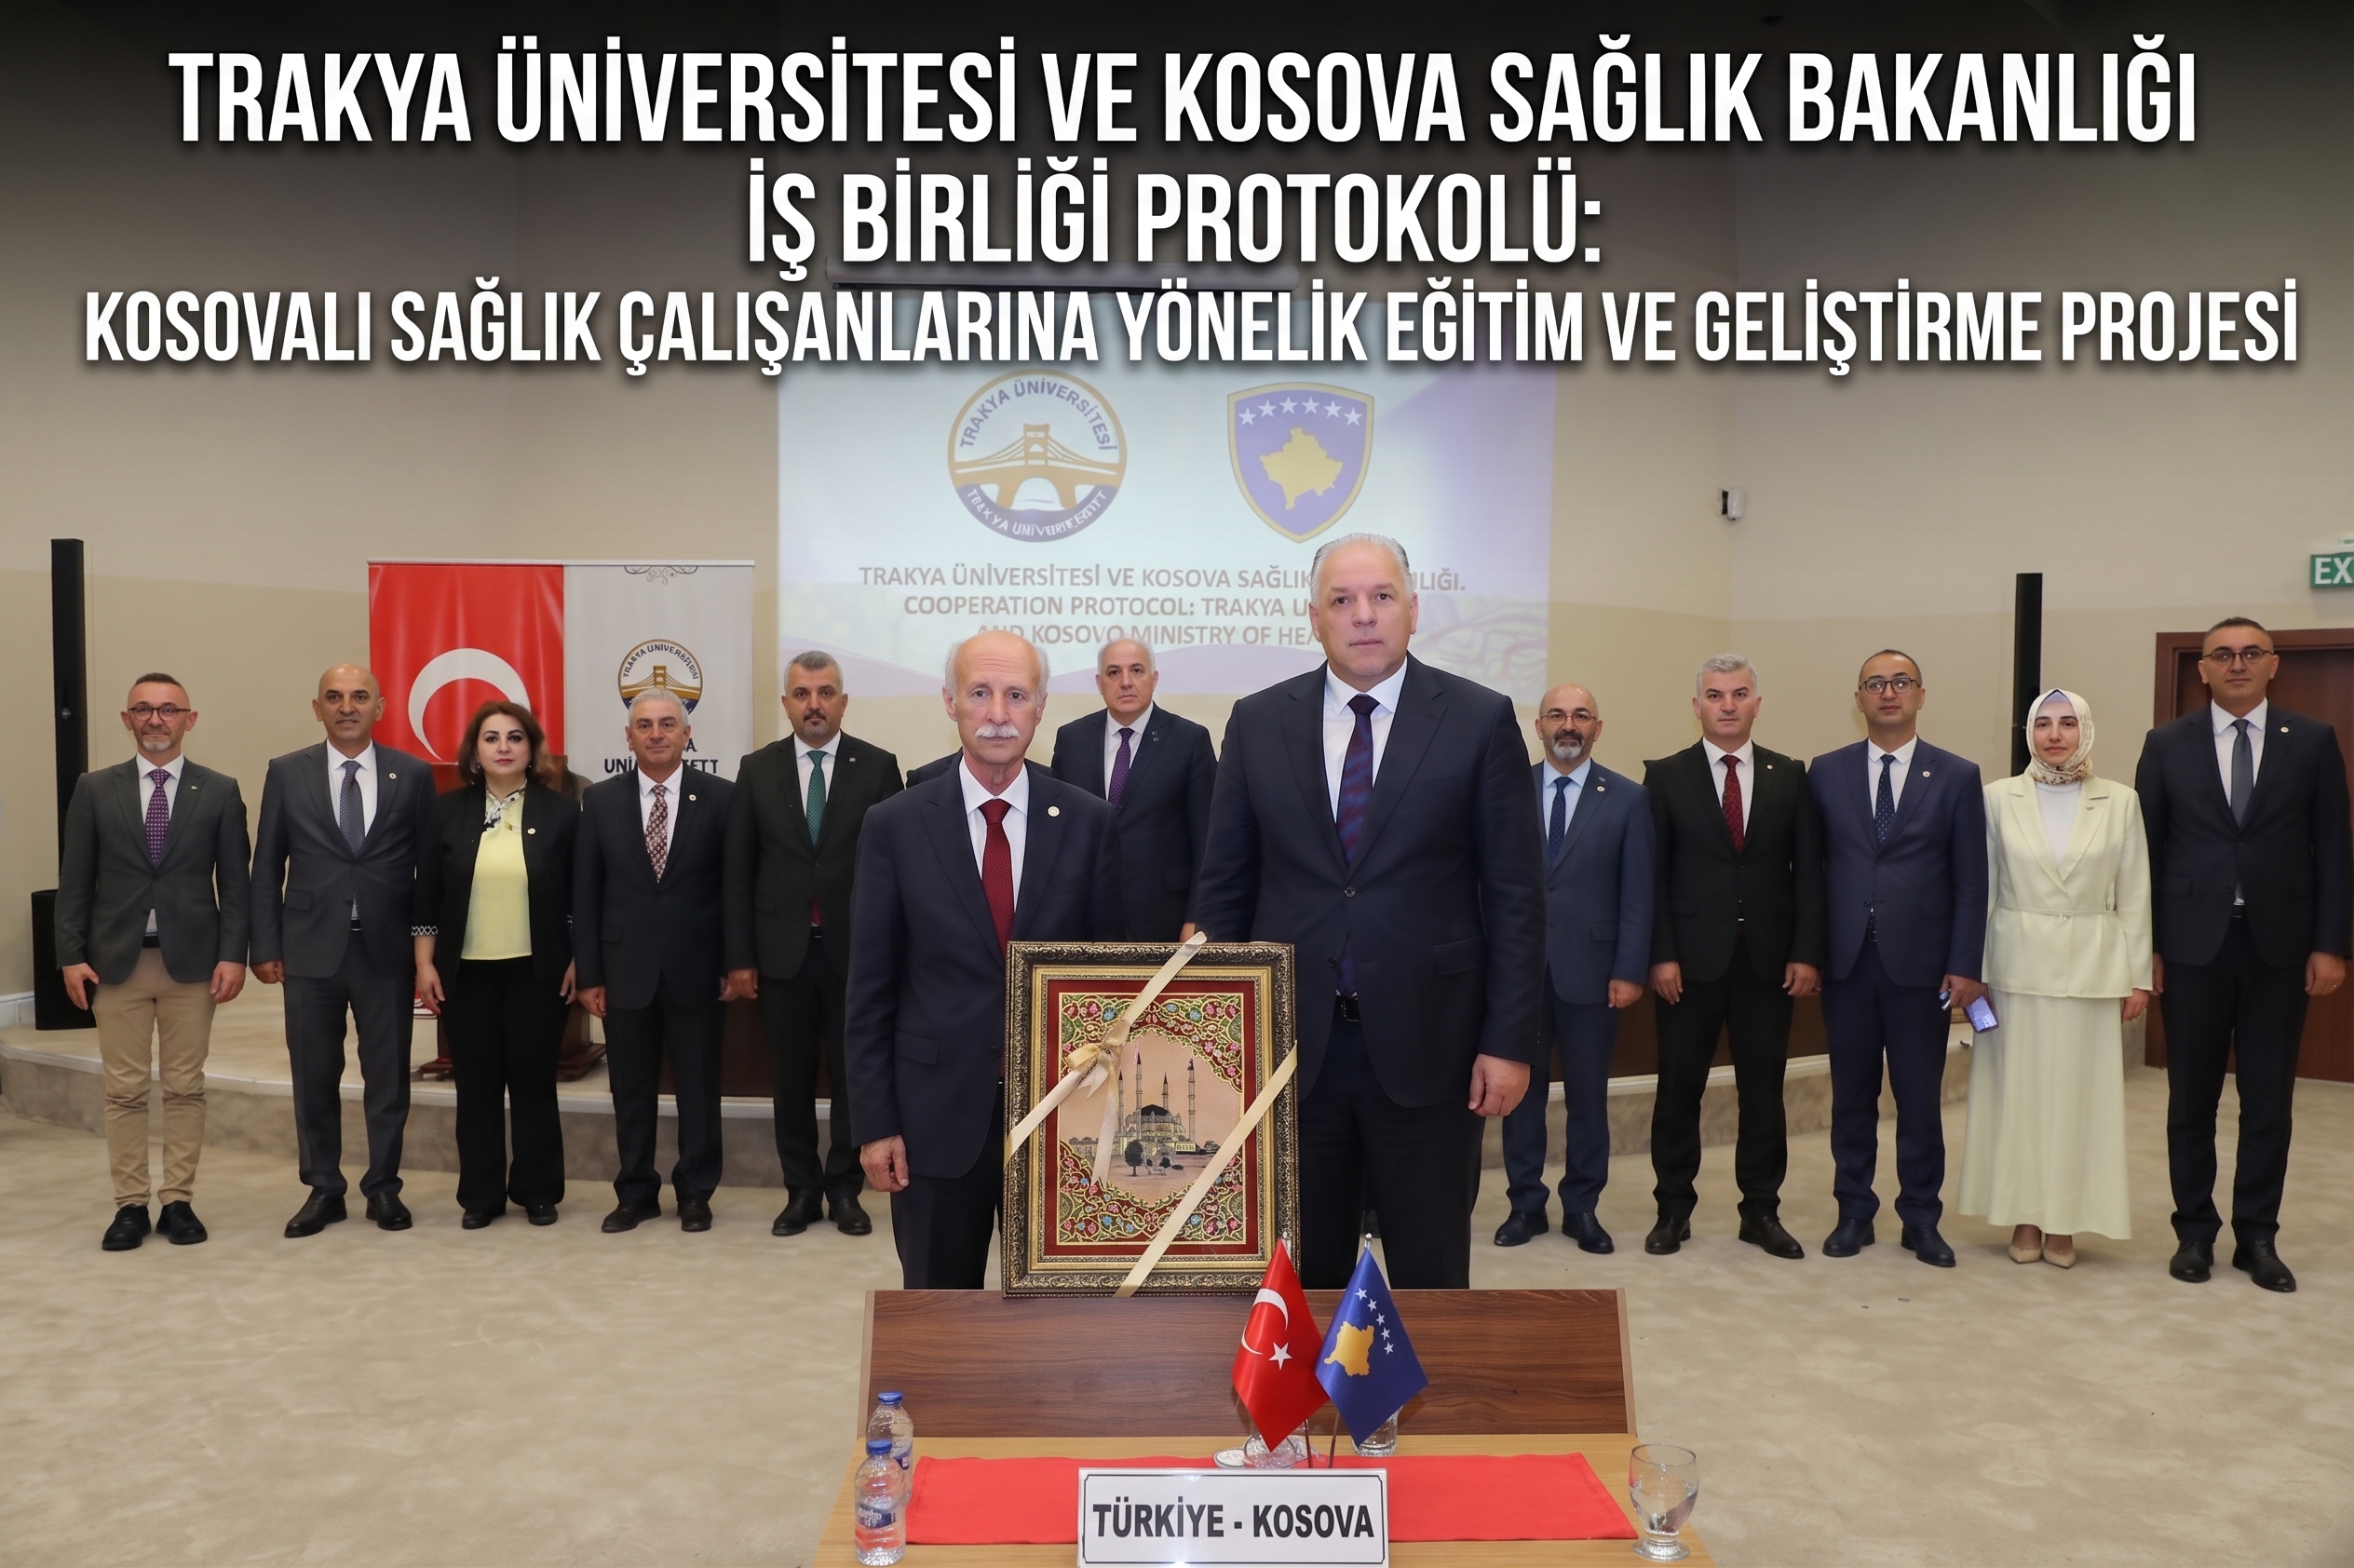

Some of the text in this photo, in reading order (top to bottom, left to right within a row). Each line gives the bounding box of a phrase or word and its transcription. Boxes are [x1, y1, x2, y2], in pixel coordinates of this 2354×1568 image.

[960, 378, 1117, 451] TRAKYA ÜNİVERSİTESİ
[859, 566, 946, 586] TRAKYA
[953, 562, 1100, 587] ÜNİVERSİTESİ
[1106, 567, 1134, 587] VE
[1142, 568, 1231, 588] KOSOVA
[903, 595, 1063, 615] COOPERATION
[1071, 597, 1195, 616] PROTOCOL:
[1200, 598, 1285, 617] TRAKYA
[1032, 624, 1125, 644] KOSOVO
[1242, 626, 1272, 646] OF
[1092, 1495, 1224, 1537] TÜRKİYE
[1252, 1504, 1375, 1538] KOSOVA
